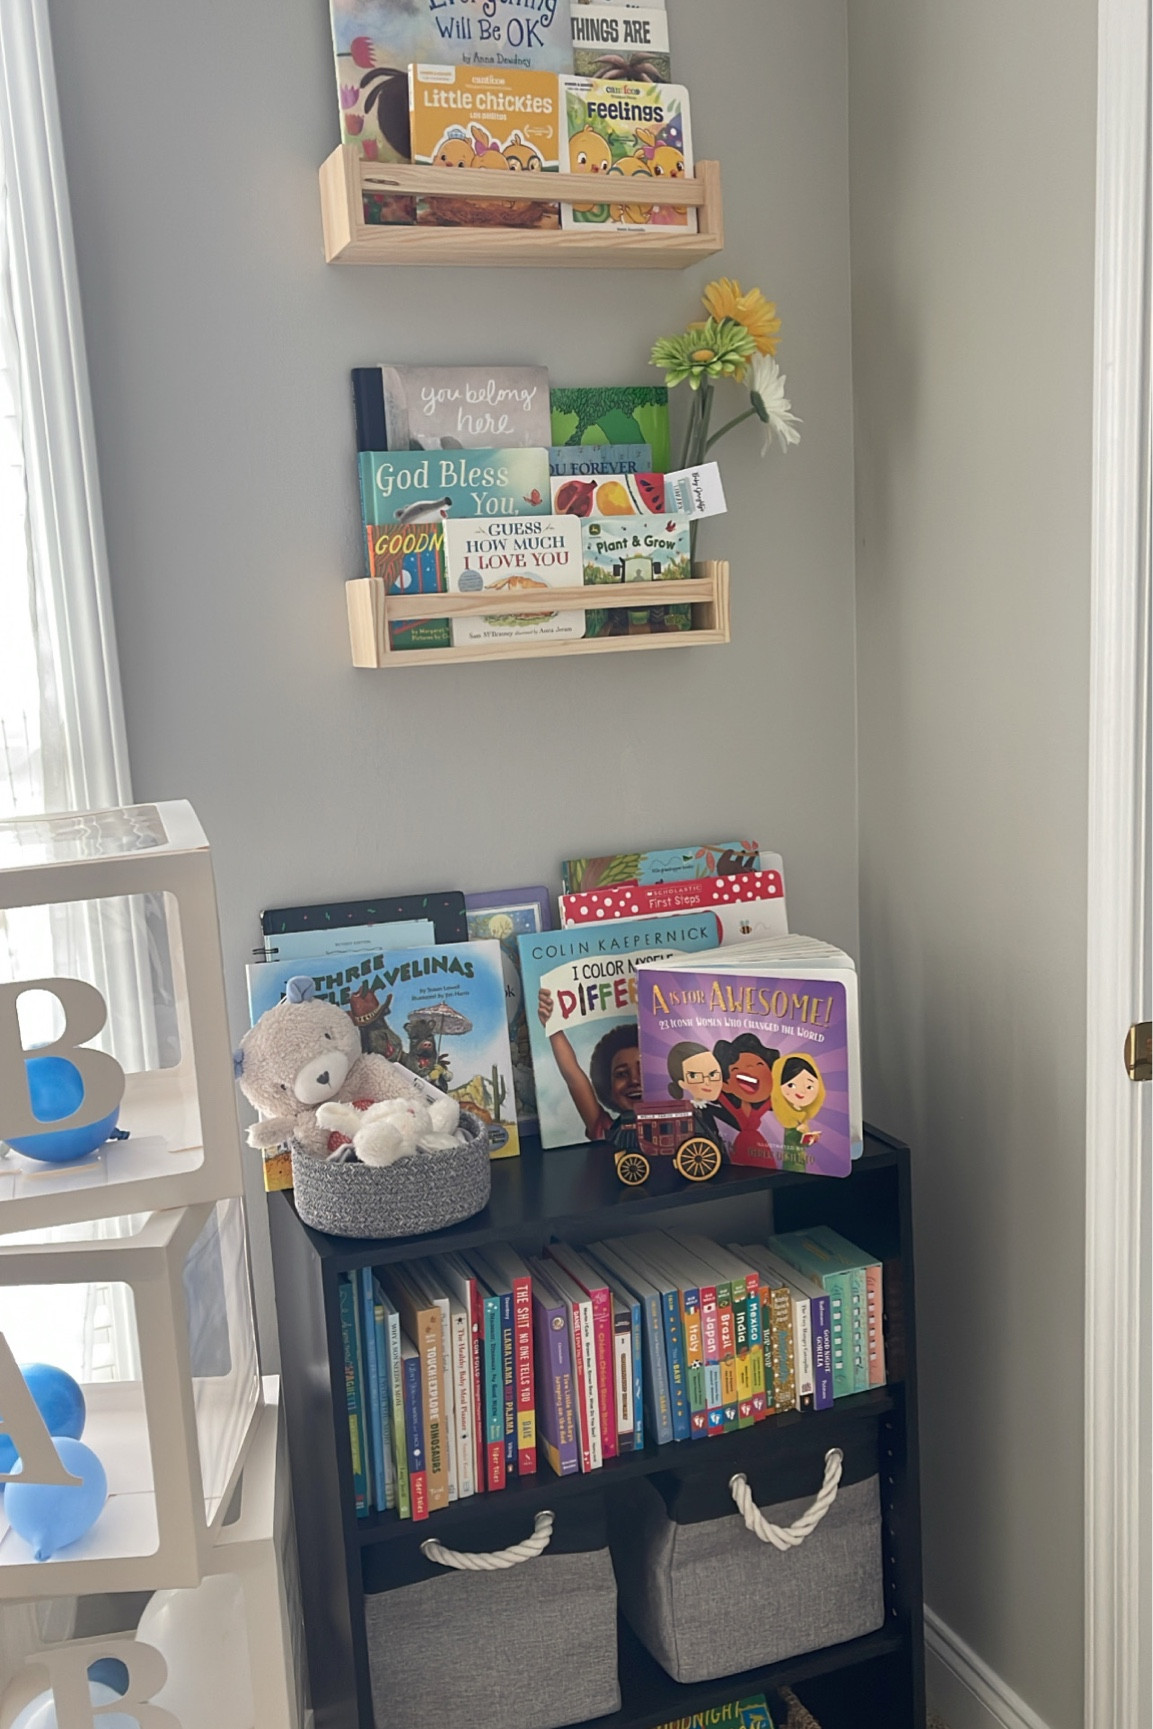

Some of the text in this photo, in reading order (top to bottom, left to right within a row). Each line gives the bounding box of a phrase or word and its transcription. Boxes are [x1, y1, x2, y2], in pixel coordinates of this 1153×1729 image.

[435, 17, 544, 48] Will Be OK
[570, 17, 651, 44] THINGS ARE
[472, 52, 495, 64] Anna
[497, 53, 531, 68] Dewdney
[424, 88, 472, 109] Little
[587, 101, 664, 122] Feelings
[421, 379, 537, 416] you belong
[457, 406, 514, 435] here
[375, 459, 510, 497] God Bless
[571, 461, 638, 475] FOREVER
[470, 491, 519, 516] You,
[488, 521, 542, 537] GUESS
[466, 536, 565, 553] HOW MUCH
[596, 535, 676, 554] Plant & Grow
[464, 551, 569, 570] I LOVE YOU
[649, 894, 701, 909] First Steps
[653, 885, 701, 896] SCHOLASTIC
[532, 926, 709, 960] COLIN KAEPERNICK
[312, 954, 385, 992] THREE
[571, 966, 580, 981] I
[582, 961, 625, 980] COLOR
[652, 984, 670, 1016] A
[709, 980, 833, 1028] AWESOME!
[659, 1016, 825, 1043] 23 ICONIC WOMEN WHO CHANGED THE WORLD
[705, 1316, 716, 1353] Japan
[721, 1313, 732, 1348] Brazil
[736, 1312, 747, 1343] India
[749, 1303, 760, 1340] Mexico
[503, 1328, 512, 1357] LLAMA
[516, 1285, 531, 1402] THE SHIT NO ONE TELLS YOU
[688, 1324, 699, 1352] Italy
[816, 1336, 824, 1367] GORILLA
[458, 1343, 466, 1369] Healthy
[426, 1346, 439, 1419] TOUCH EXPLORE
[458, 1370, 467, 1387] Baby
[504, 1357, 513, 1385] LLAMA
[673, 1364, 681, 1384] BABY
[460, 1388, 468, 1405] Meal
[564, 1390, 572, 1408] Little
[506, 1401, 514, 1434] PAJAMA
[558, 1407, 563, 1416] on
[522, 1421, 532, 1438] DAIS
[430, 1423, 441, 1474] DINOSAURS
